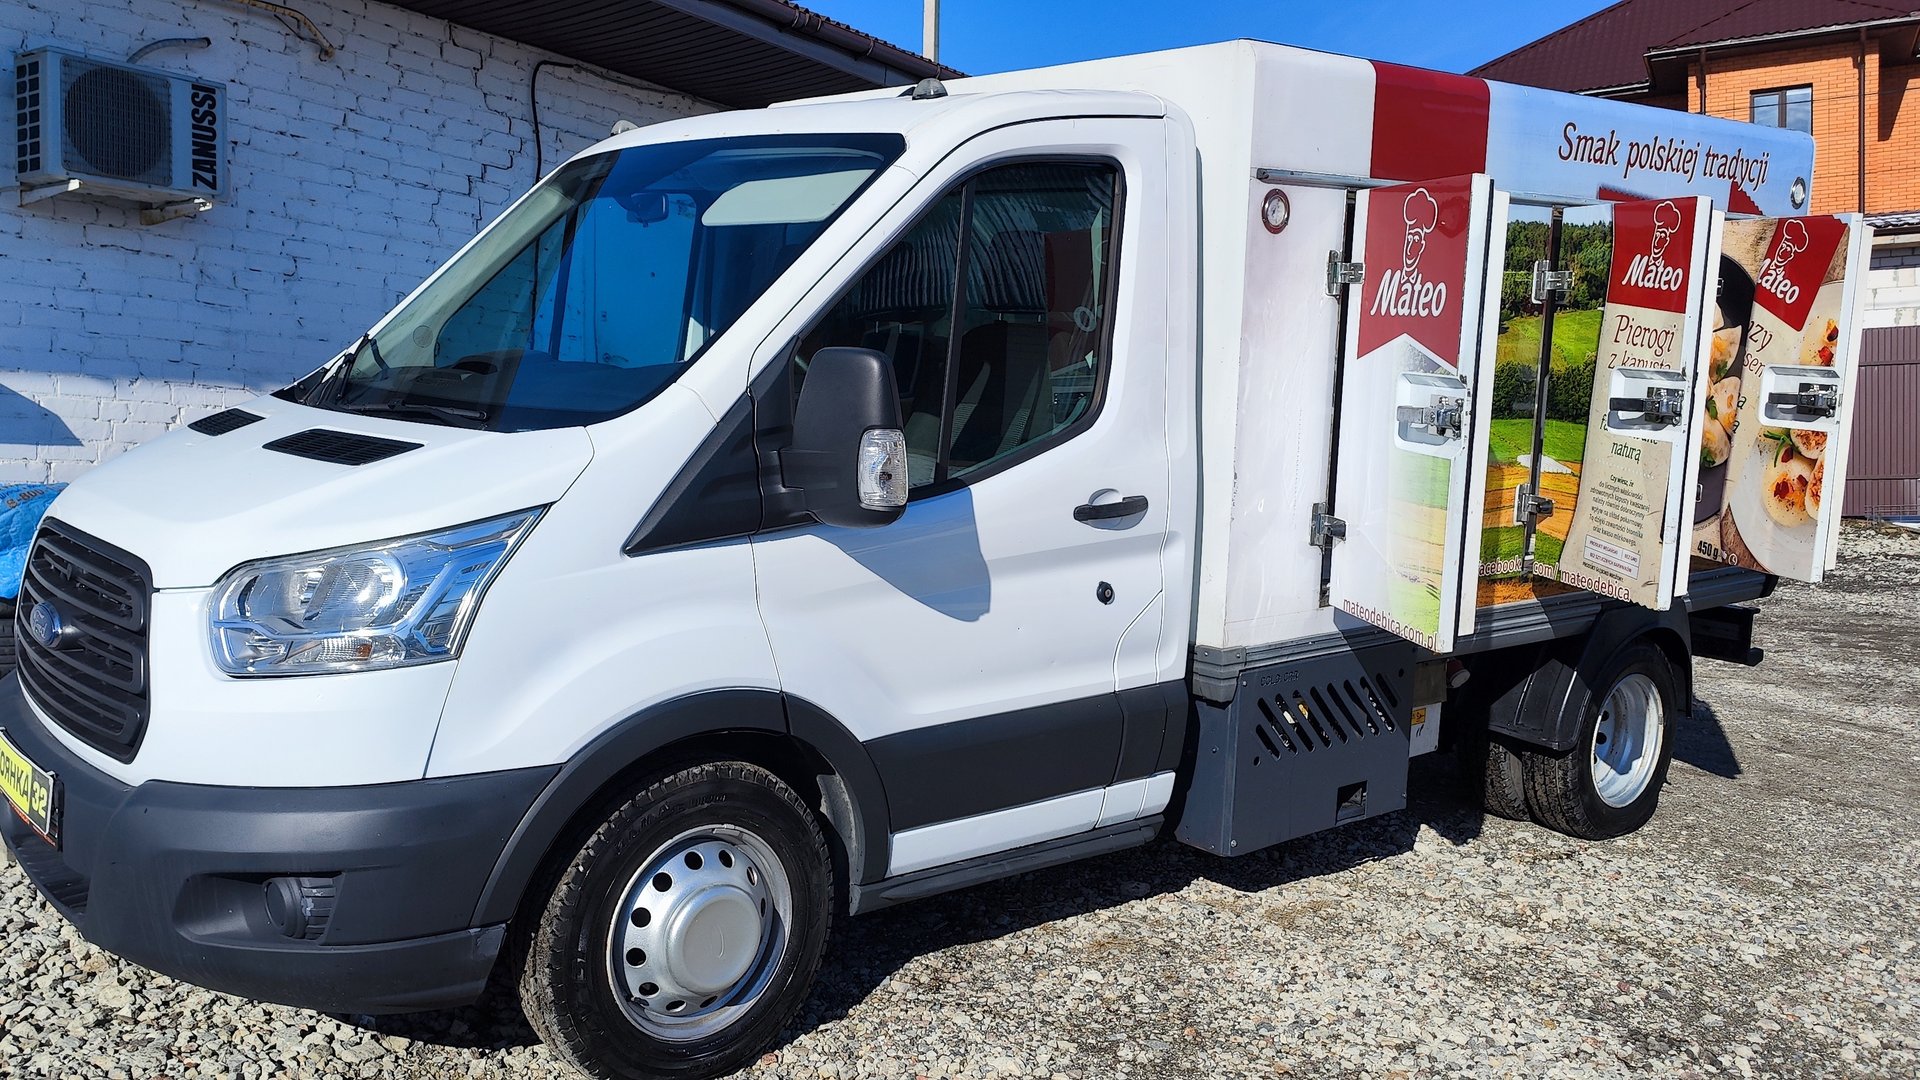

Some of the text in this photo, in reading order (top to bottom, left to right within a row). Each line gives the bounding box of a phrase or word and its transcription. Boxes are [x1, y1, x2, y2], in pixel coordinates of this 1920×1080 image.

[191, 83, 217, 191] ZANUSSI
[1558, 121, 1770, 192] Smak polskiej tradycji
[1370, 269, 1447, 317] Mateo
[1621, 254, 1683, 292] Mateo
[1613, 314, 1677, 357] Pierogi
[1608, 353, 1617, 369] z
[1610, 442, 1641, 464] naturą
[1697, 540, 1719, 560] 450 g
[1343, 599, 1438, 651] mateodebica.com.pl
[31, 781, 47, 819] 32
